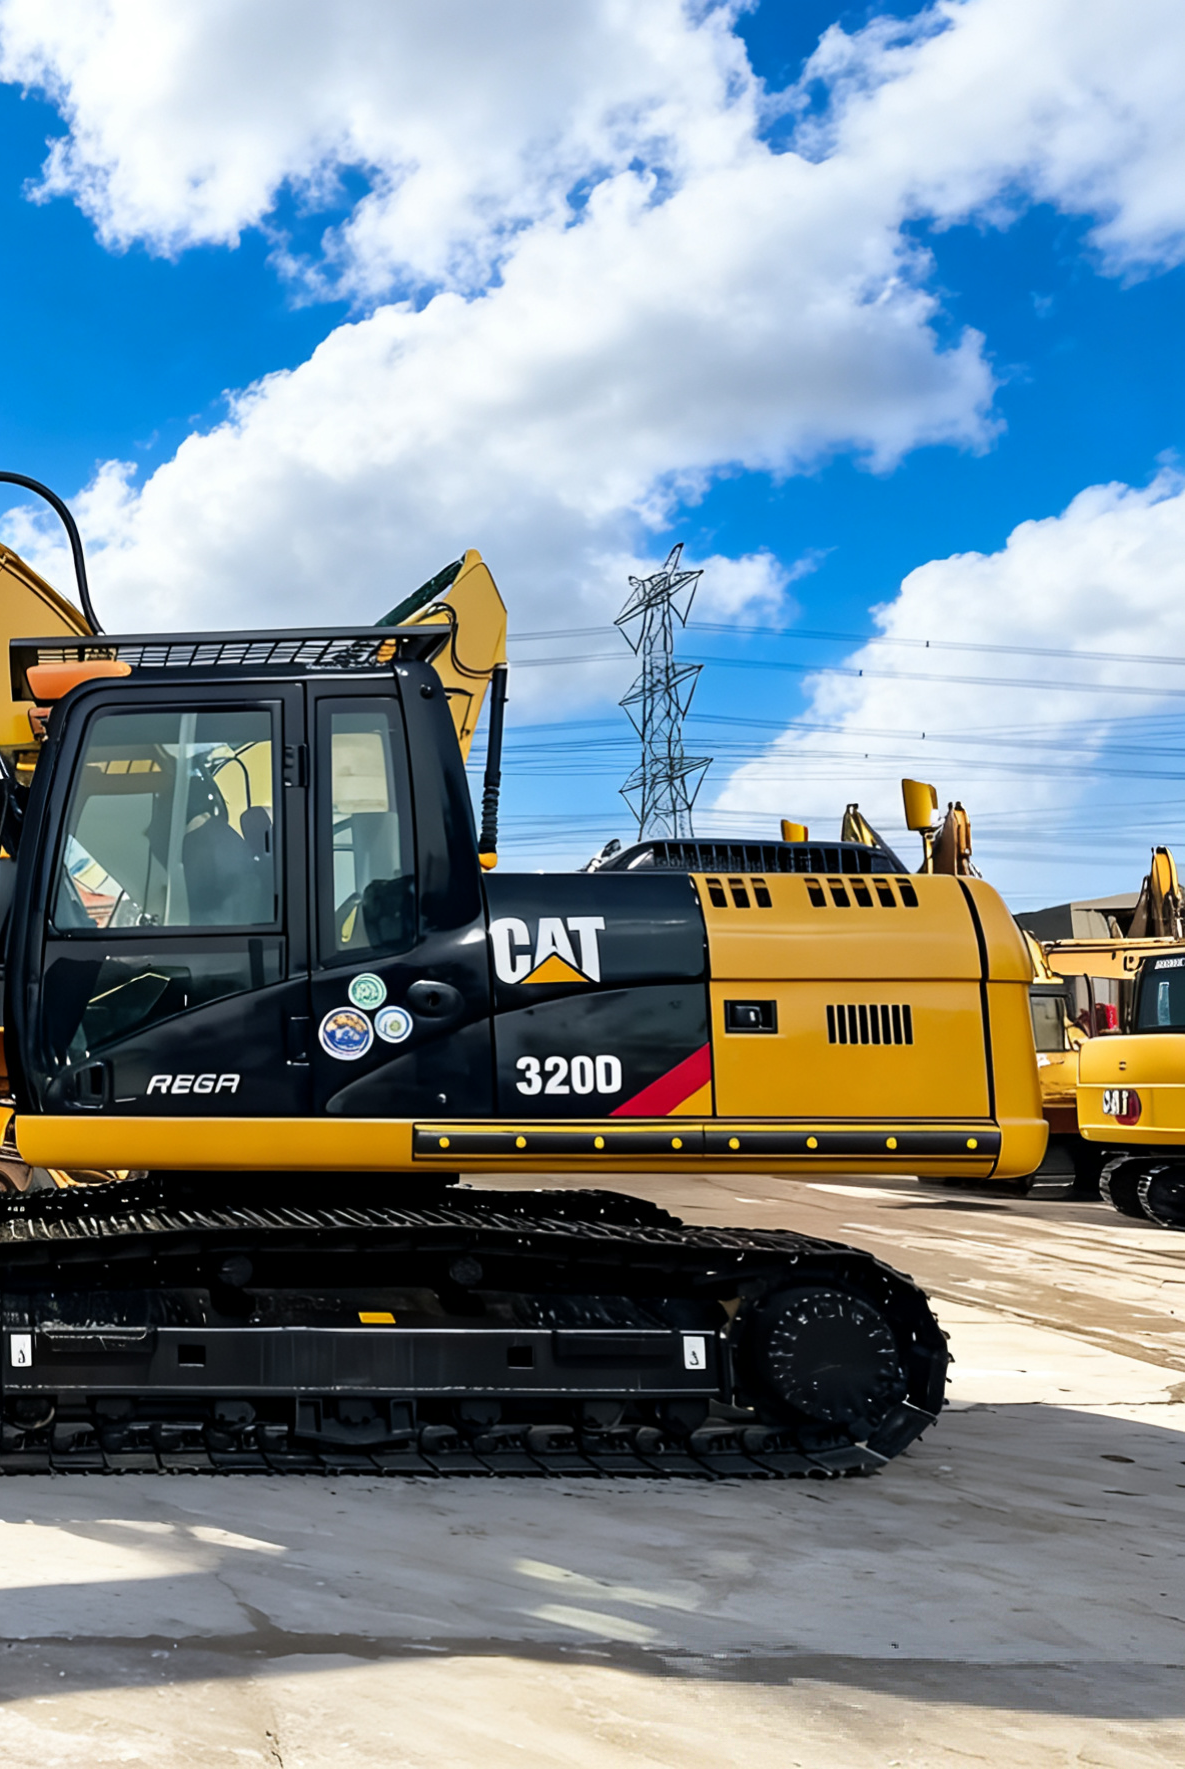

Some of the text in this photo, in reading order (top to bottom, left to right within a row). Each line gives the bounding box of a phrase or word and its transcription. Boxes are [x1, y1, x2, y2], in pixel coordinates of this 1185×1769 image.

[489, 916, 606, 984] CAT
[146, 1073, 240, 1095] REGA
[516, 1055, 622, 1095] 320D
